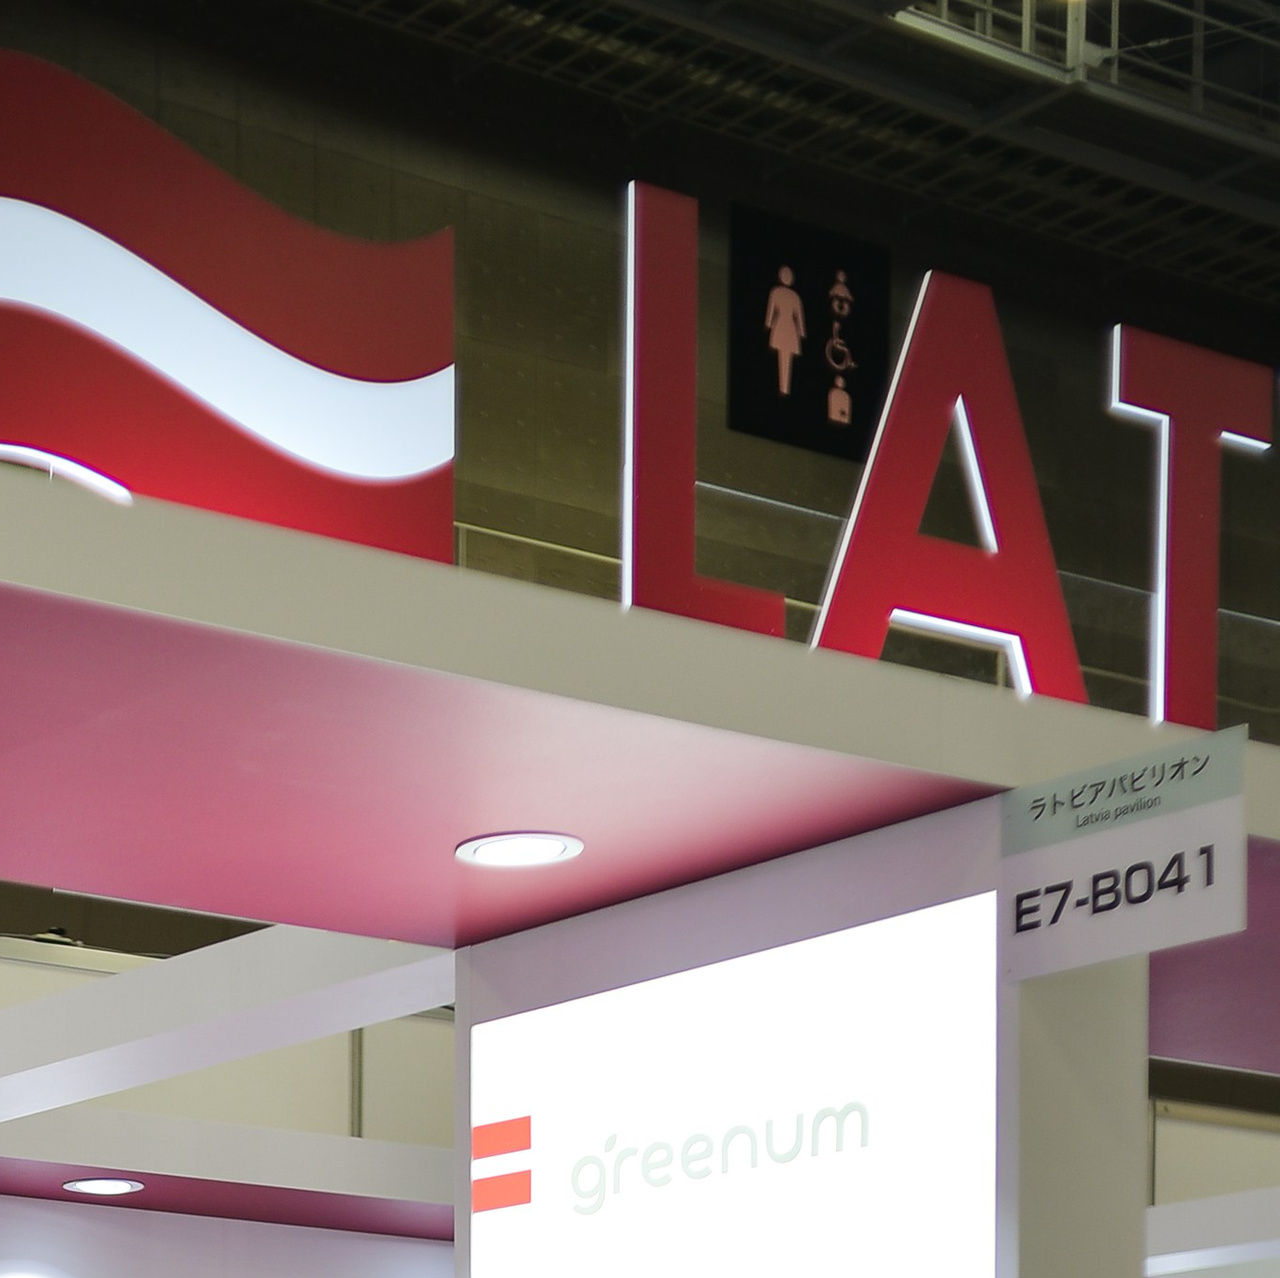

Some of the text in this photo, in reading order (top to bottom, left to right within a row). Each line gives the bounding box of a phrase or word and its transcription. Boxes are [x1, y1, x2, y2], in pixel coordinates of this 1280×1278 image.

[622, 180, 1273, 731] LAT
[1029, 755, 1211, 822] ラトビアパビリオン
[1076, 795, 1161, 828] Latvia pavilion
[1015, 844, 1215, 934] E7-B041
[571, 1101, 869, 1216] greenum
